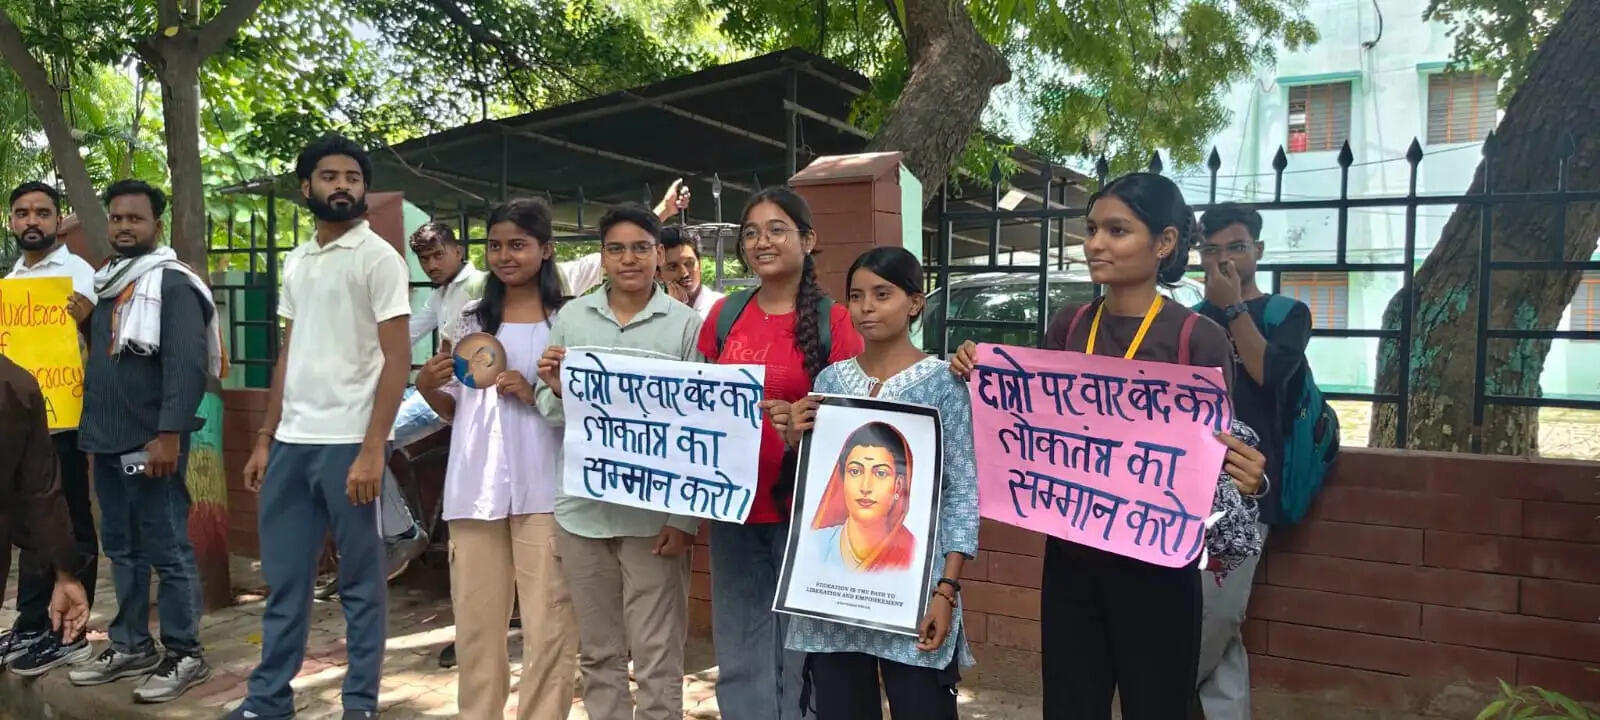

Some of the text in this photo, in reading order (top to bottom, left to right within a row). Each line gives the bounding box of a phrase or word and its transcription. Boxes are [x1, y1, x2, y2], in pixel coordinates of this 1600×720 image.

[0, 288, 67, 327] urderer
[0, 331, 11, 354] f
[726, 340, 769, 362] Red
[615, 372, 650, 414] पर
[647, 375, 687, 416] वार
[684, 370, 721, 412] बंद
[720, 368, 764, 429] करो
[1037, 372, 1086, 416] पर
[1080, 373, 1135, 421] वार
[1128, 370, 1170, 423] बंद
[584, 403, 727, 468] लोकतंत्र का
[998, 412, 1186, 489] लोकतंत्र का
[583, 457, 681, 508] सम्मान
[1008, 469, 1129, 540] सम्मान
